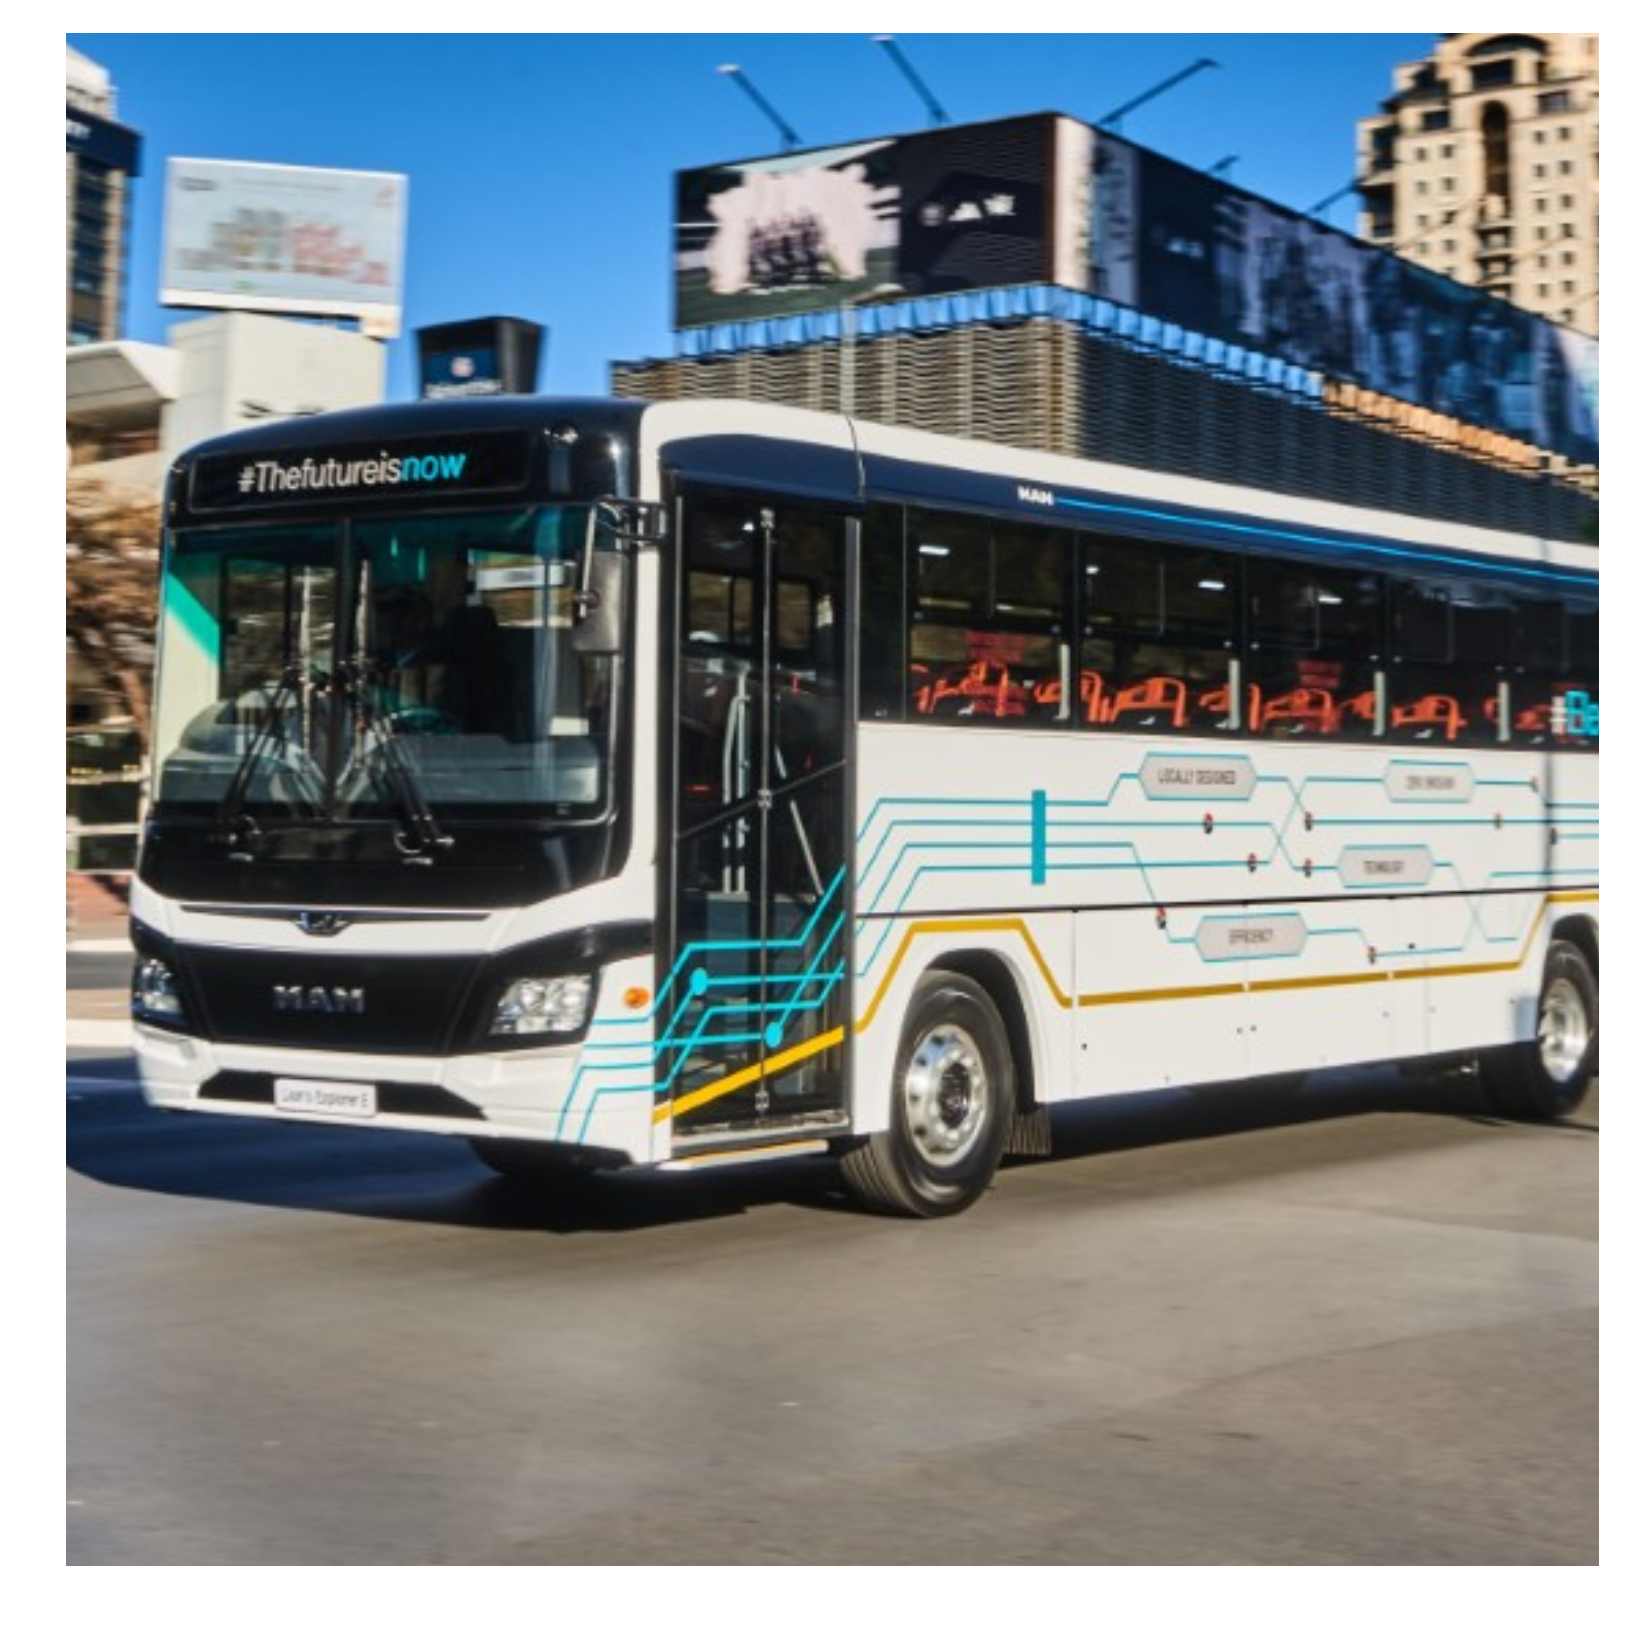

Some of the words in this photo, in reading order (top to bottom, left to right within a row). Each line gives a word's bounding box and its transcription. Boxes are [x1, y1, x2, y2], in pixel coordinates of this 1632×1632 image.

[238, 450, 466, 493] #Thefutureisnow
[1017, 486, 1054, 506] MAN
[273, 986, 364, 1013] MAN
